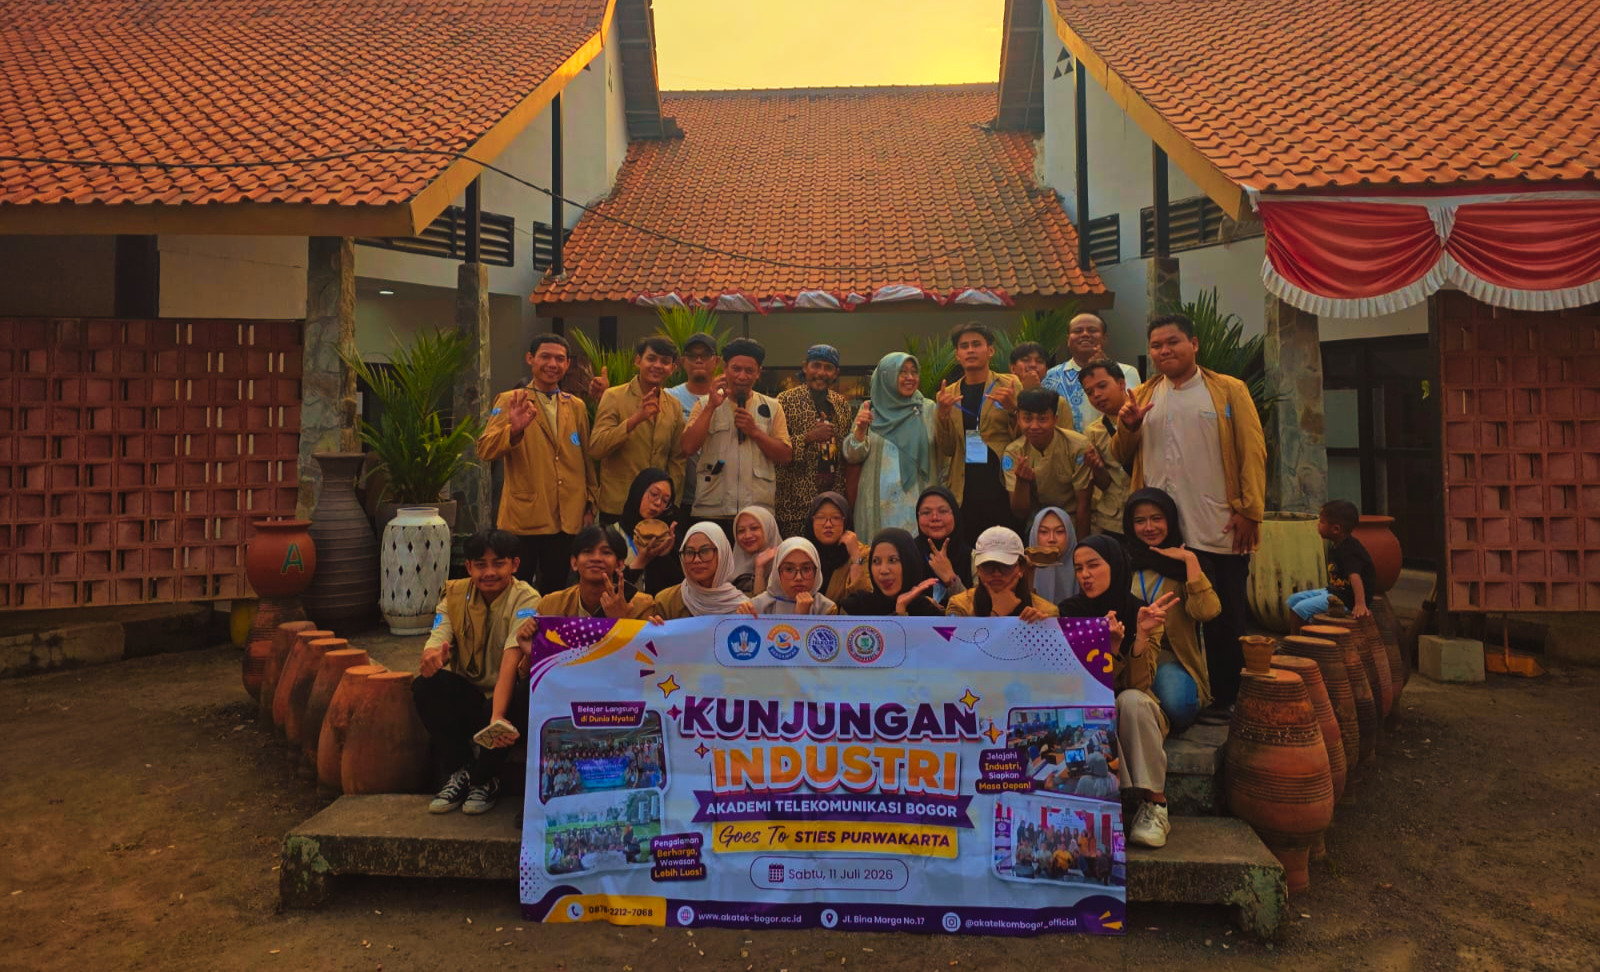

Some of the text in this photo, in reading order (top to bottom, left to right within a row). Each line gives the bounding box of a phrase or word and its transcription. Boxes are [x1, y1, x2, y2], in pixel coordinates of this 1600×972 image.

[281, 542, 304, 573] A
[577, 705, 639, 714] Belajar Langsung
[611, 715, 636, 723] Nyata!
[682, 695, 980, 737] KUNJUNGAN
[986, 752, 1018, 760] Jelajahi
[712, 746, 958, 791] INDUSTRI
[984, 762, 1022, 771] Industri,
[988, 772, 1020, 780] Siapkan
[1002, 782, 1032, 790] Depan!
[706, 800, 958, 818] AKADEMI TELEKOMUNIKASI BOGOR
[718, 825, 950, 847] Goes To STIES PURWAKARTA
[654, 837, 699, 848] Pengalaman
[657, 848, 698, 858] Berharga,
[660, 858, 696, 867] Wawasan
[654, 867, 702, 878] Lebih Luas!
[788, 868, 893, 881] Sabtu, 11 Juli 2026
[698, 913, 802, 925] www.akatek-bogor.ac.id
[853, 915, 873, 924] Bina
[874, 916, 902, 926] Marga
[903, 917, 925, 925] No.17
[965, 917, 1077, 931] @akatelkombogor_official
